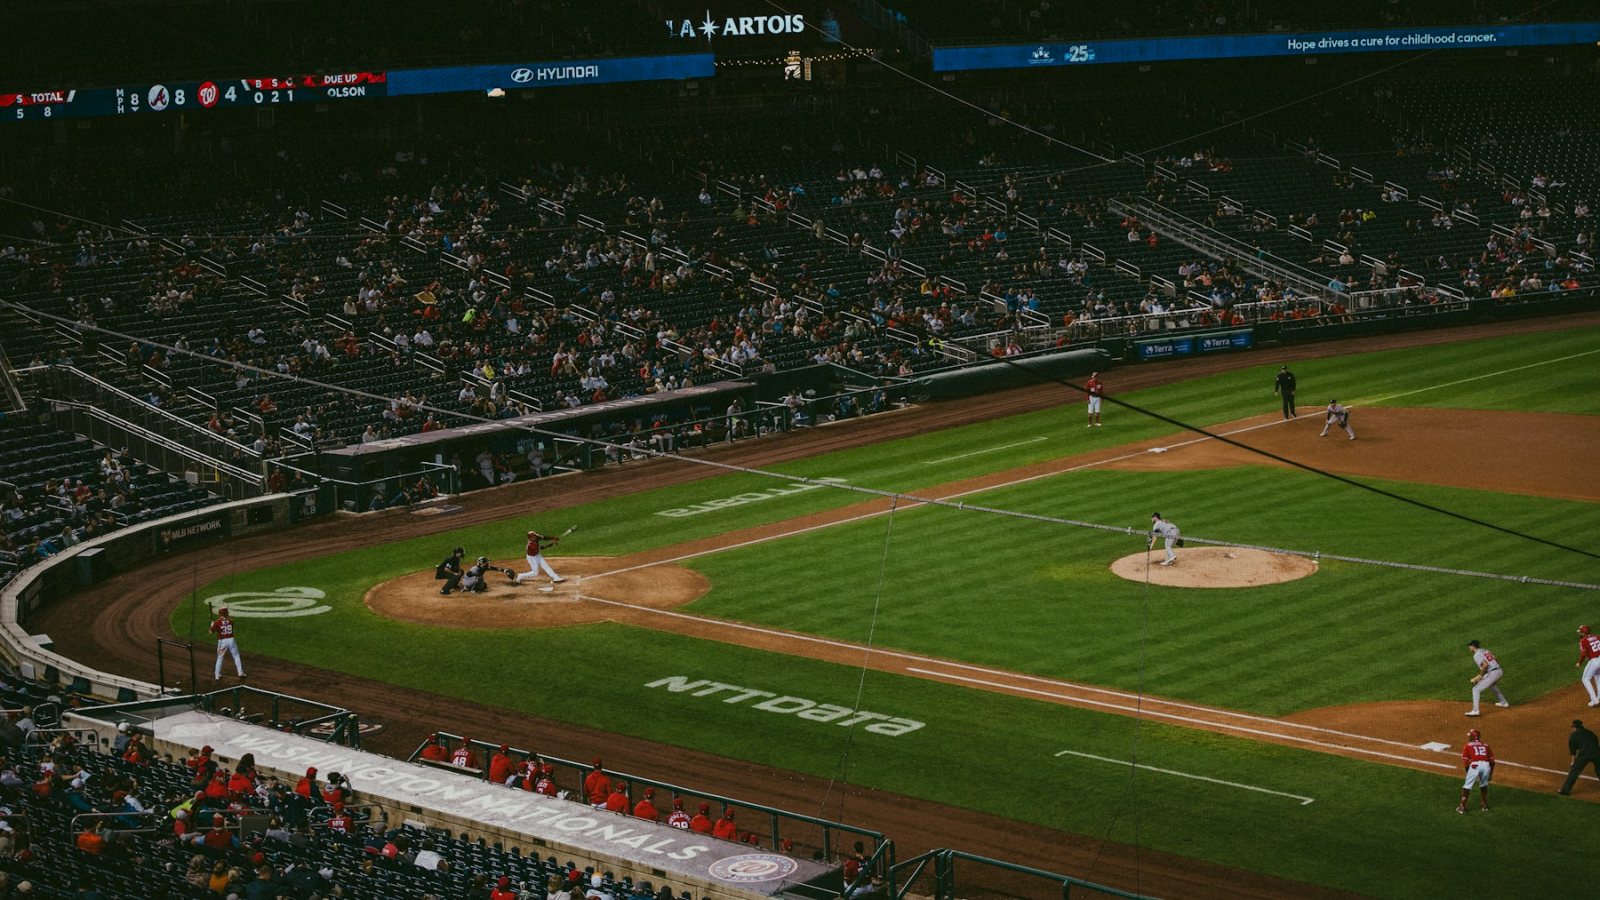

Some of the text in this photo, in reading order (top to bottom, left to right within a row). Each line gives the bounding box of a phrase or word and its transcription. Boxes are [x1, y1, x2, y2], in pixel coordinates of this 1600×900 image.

[722, 14, 805, 37] ARTOIS
[1287, 33, 1497, 52] Hope drives a cure for childhood cancer.
[1069, 45, 1089, 62] 25
[324, 74, 358, 84] DUE UP
[537, 65, 599, 80] HYUNDAI
[255, 79, 262, 88] B
[271, 78, 278, 87] S
[16, 92, 64, 104] S TOTAL
[174, 89, 186, 105] 8
[224, 86, 237, 102] 4
[254, 90, 293, 104] 0 2 1
[327, 86, 366, 98] OLSON
[130, 93, 140, 106] 8
[16, 106, 52, 119] 5 8
[1153, 345, 1173, 353] Terra
[1211, 338, 1231, 347] Terra
[187, 519, 222, 536] NETWORK
[1473, 745, 1487, 756] 12
[225, 732, 709, 860] WASHINGTON NATIONALS
